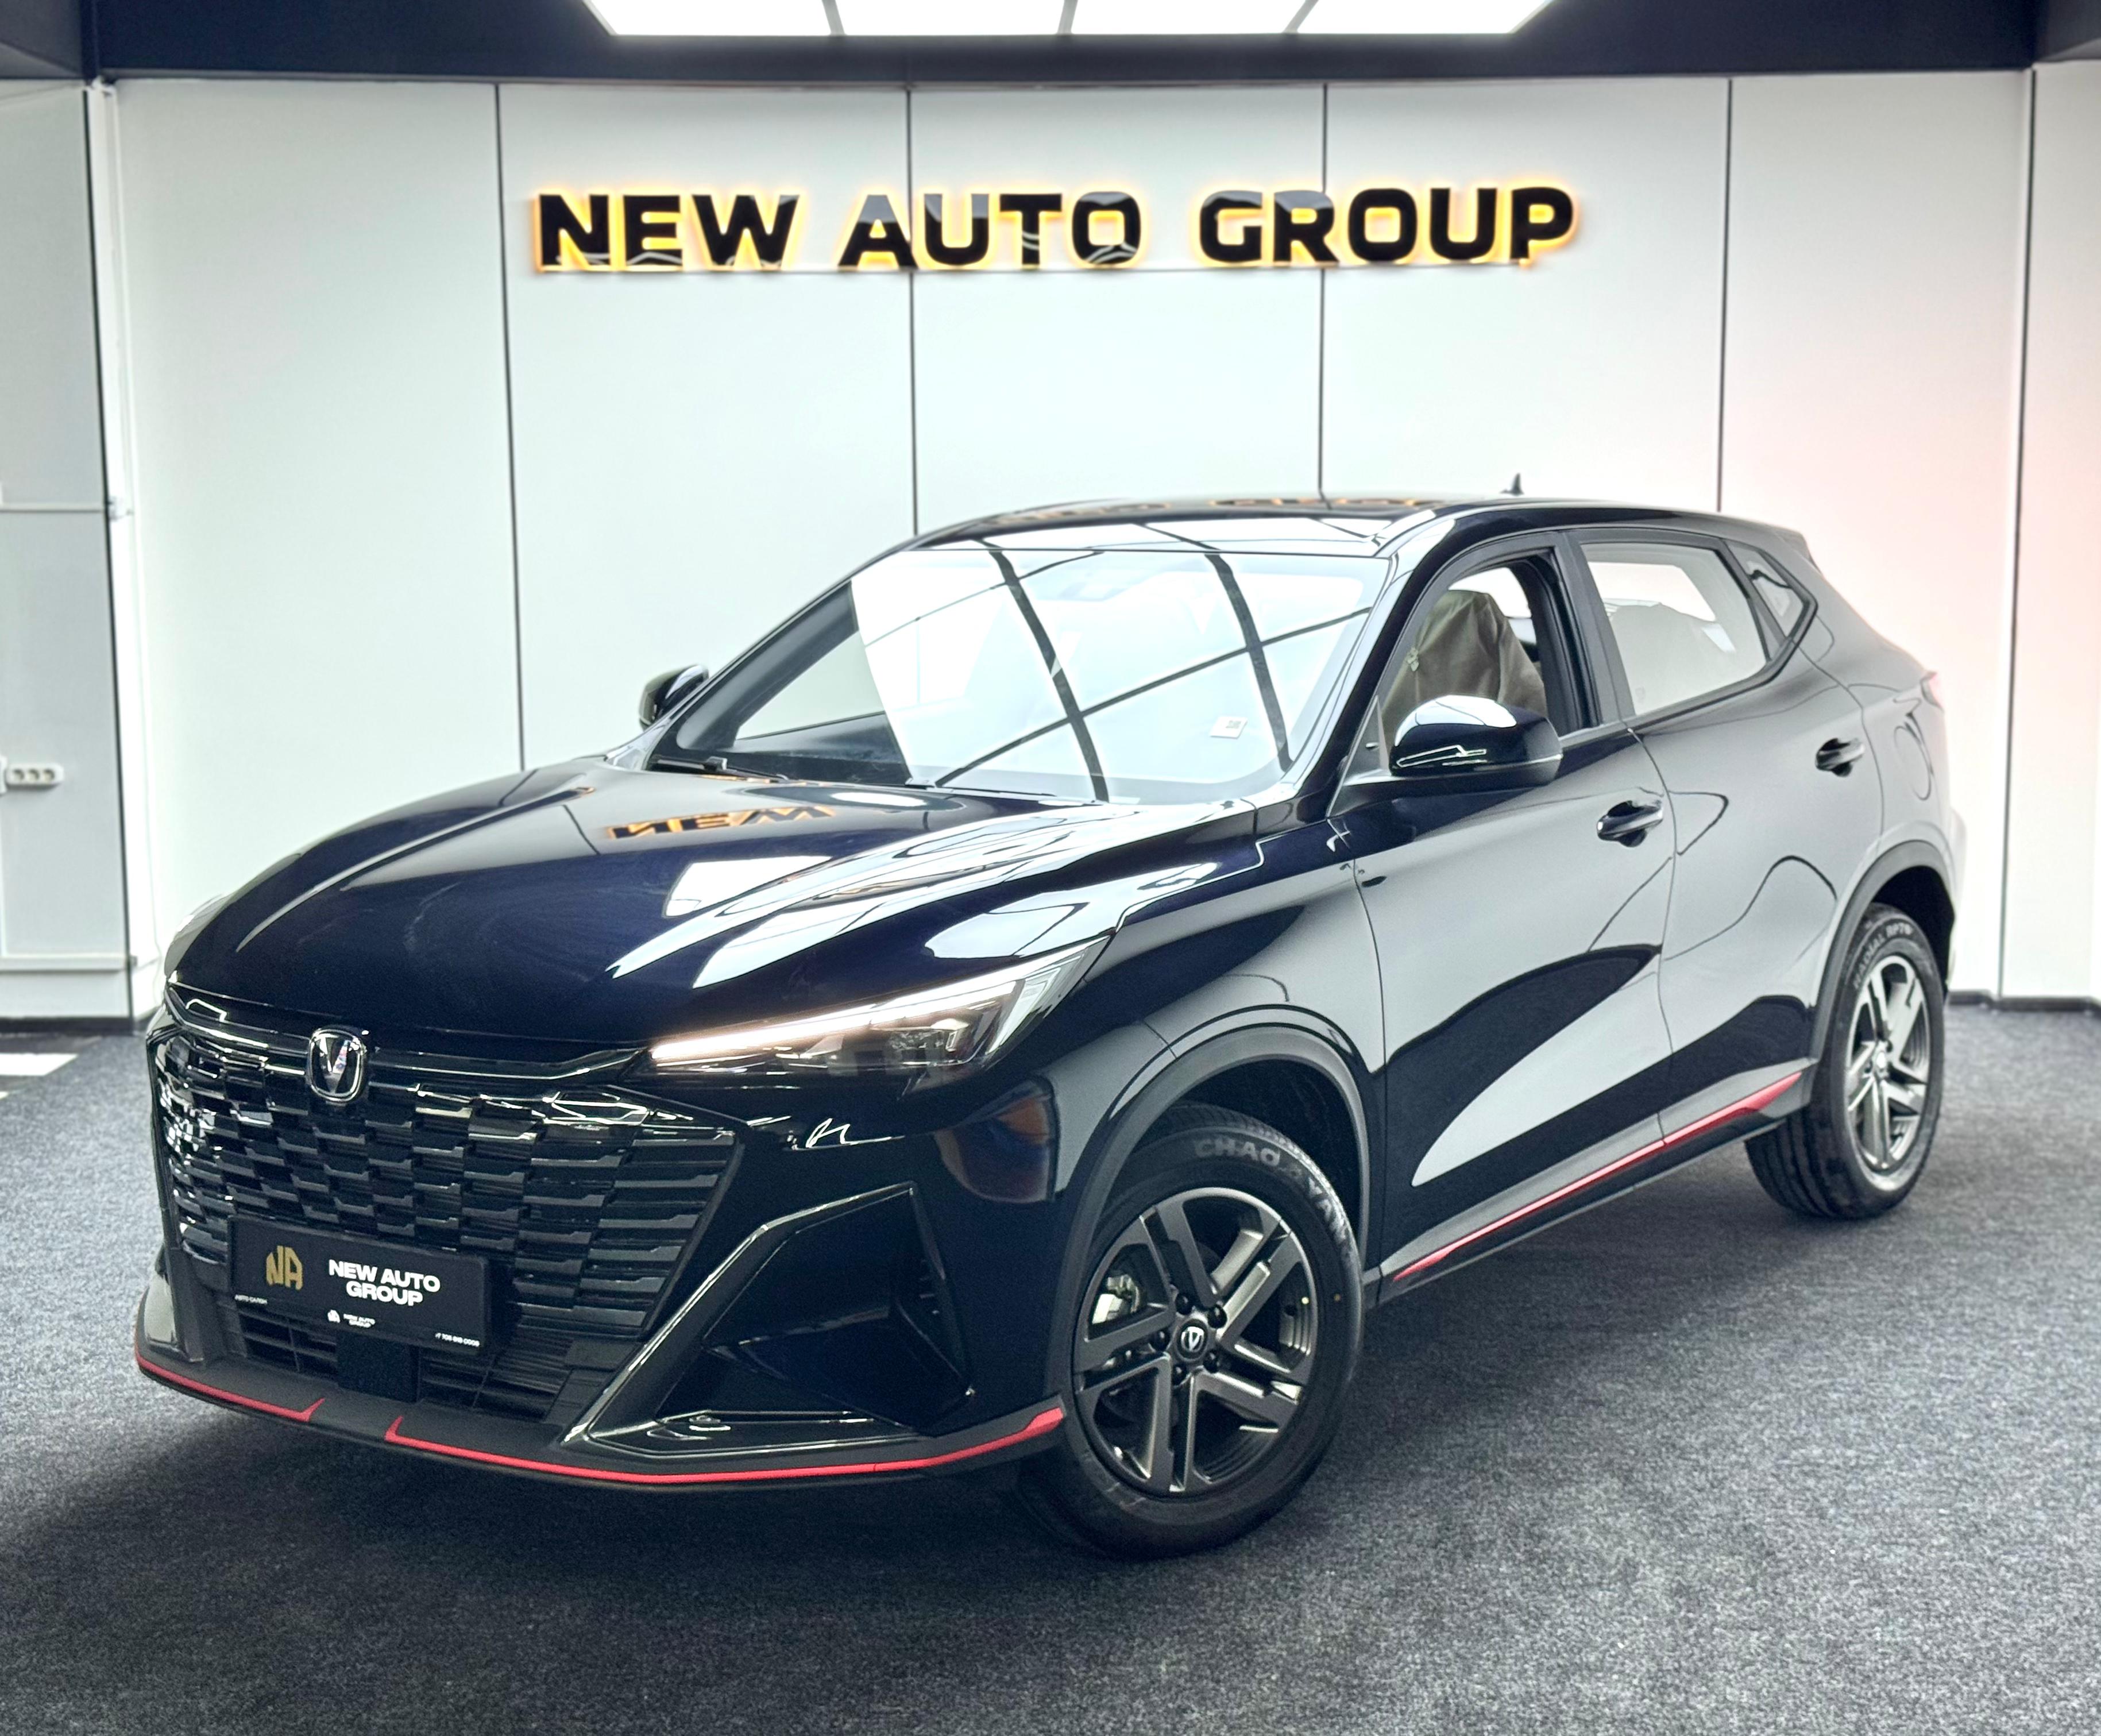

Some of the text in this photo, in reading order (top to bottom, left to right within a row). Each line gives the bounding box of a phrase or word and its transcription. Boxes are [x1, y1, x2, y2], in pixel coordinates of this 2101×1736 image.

[539, 187, 1574, 268] NEW AUTO GROUP
[266, 1245, 303, 1290] NA
[329, 1259, 441, 1293] NEW AUTO
[346, 1280, 423, 1306] GROUP
